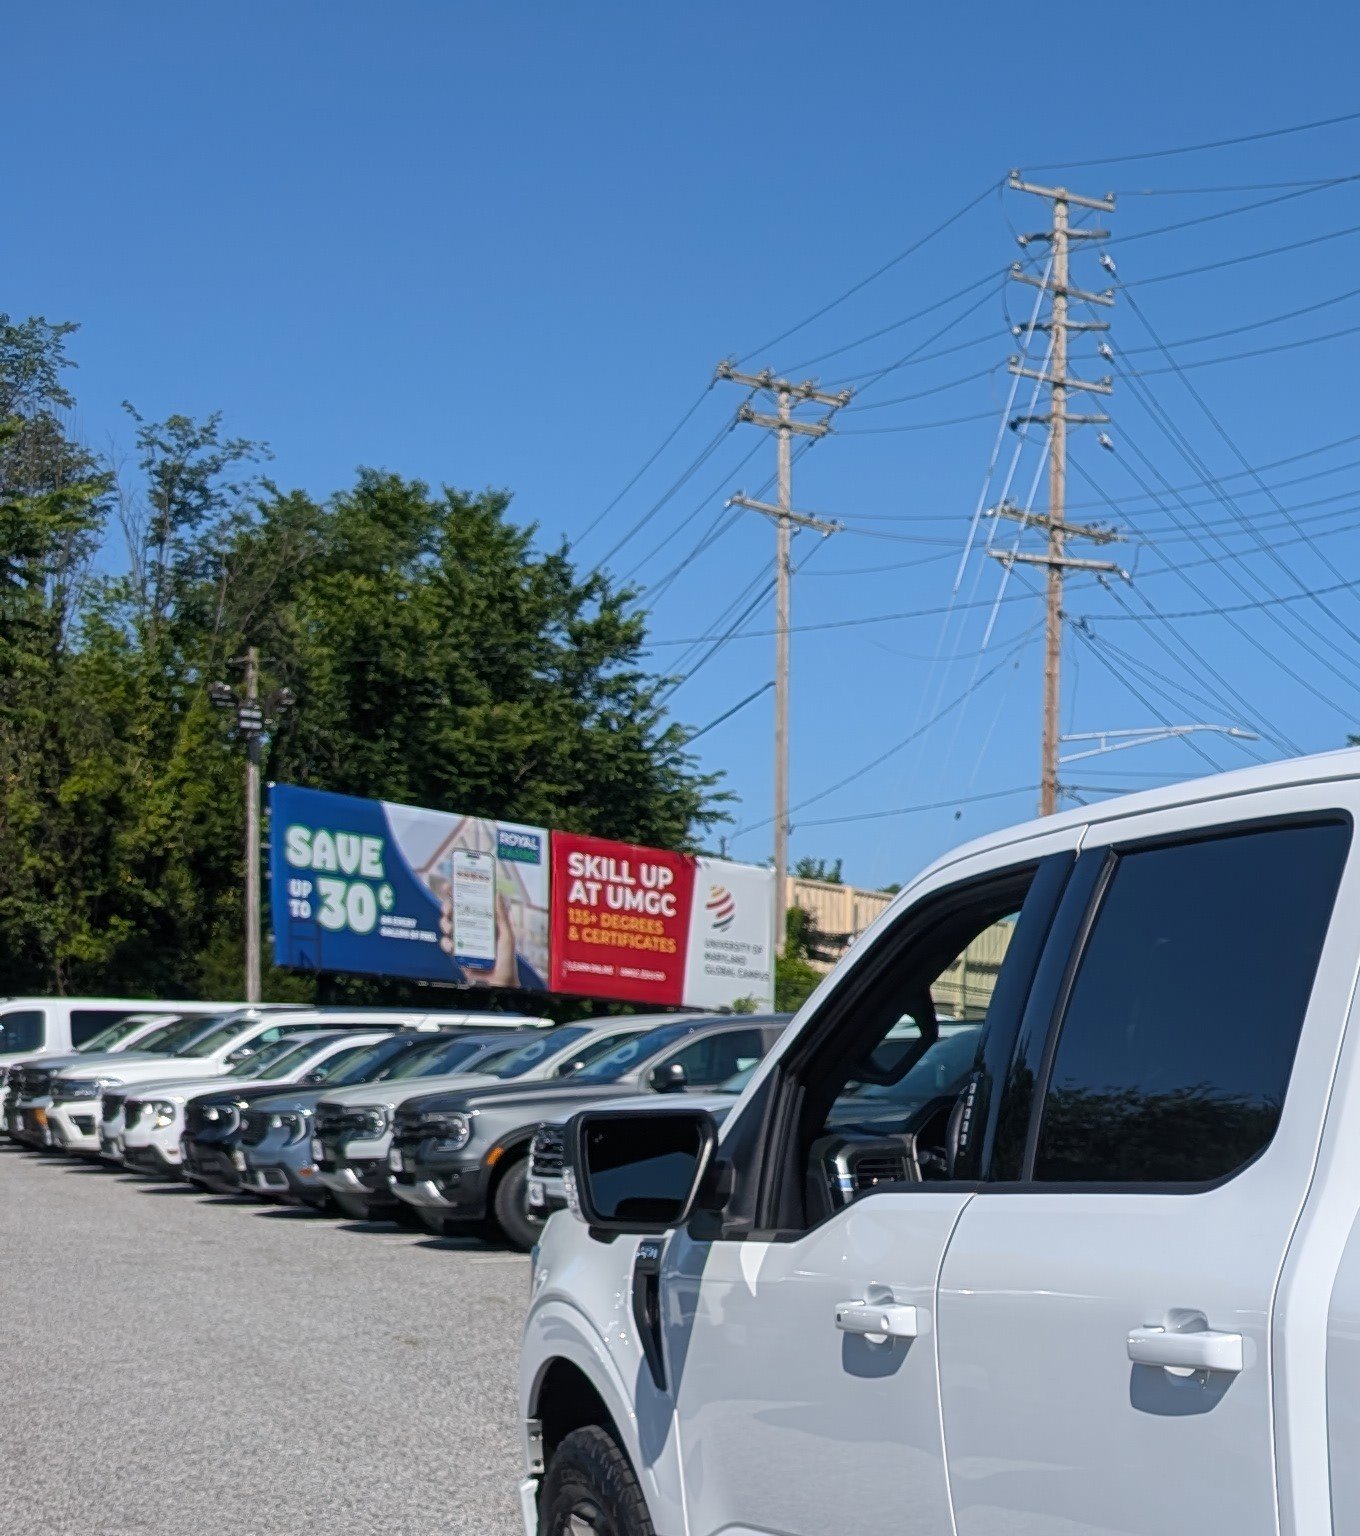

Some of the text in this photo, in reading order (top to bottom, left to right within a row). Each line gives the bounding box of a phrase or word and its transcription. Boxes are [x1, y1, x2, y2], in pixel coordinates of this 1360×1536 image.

[286, 824, 384, 879] SAVE
[499, 831, 539, 850] ROYAL
[567, 852, 636, 885] SKILL
[640, 863, 674, 890] UP
[288, 878, 313, 899] UP
[568, 879, 677, 917] AT UMGC
[288, 898, 312, 919] TO
[600, 912, 664, 935] DEGREES
[581, 927, 677, 954] CERTIFICATES
